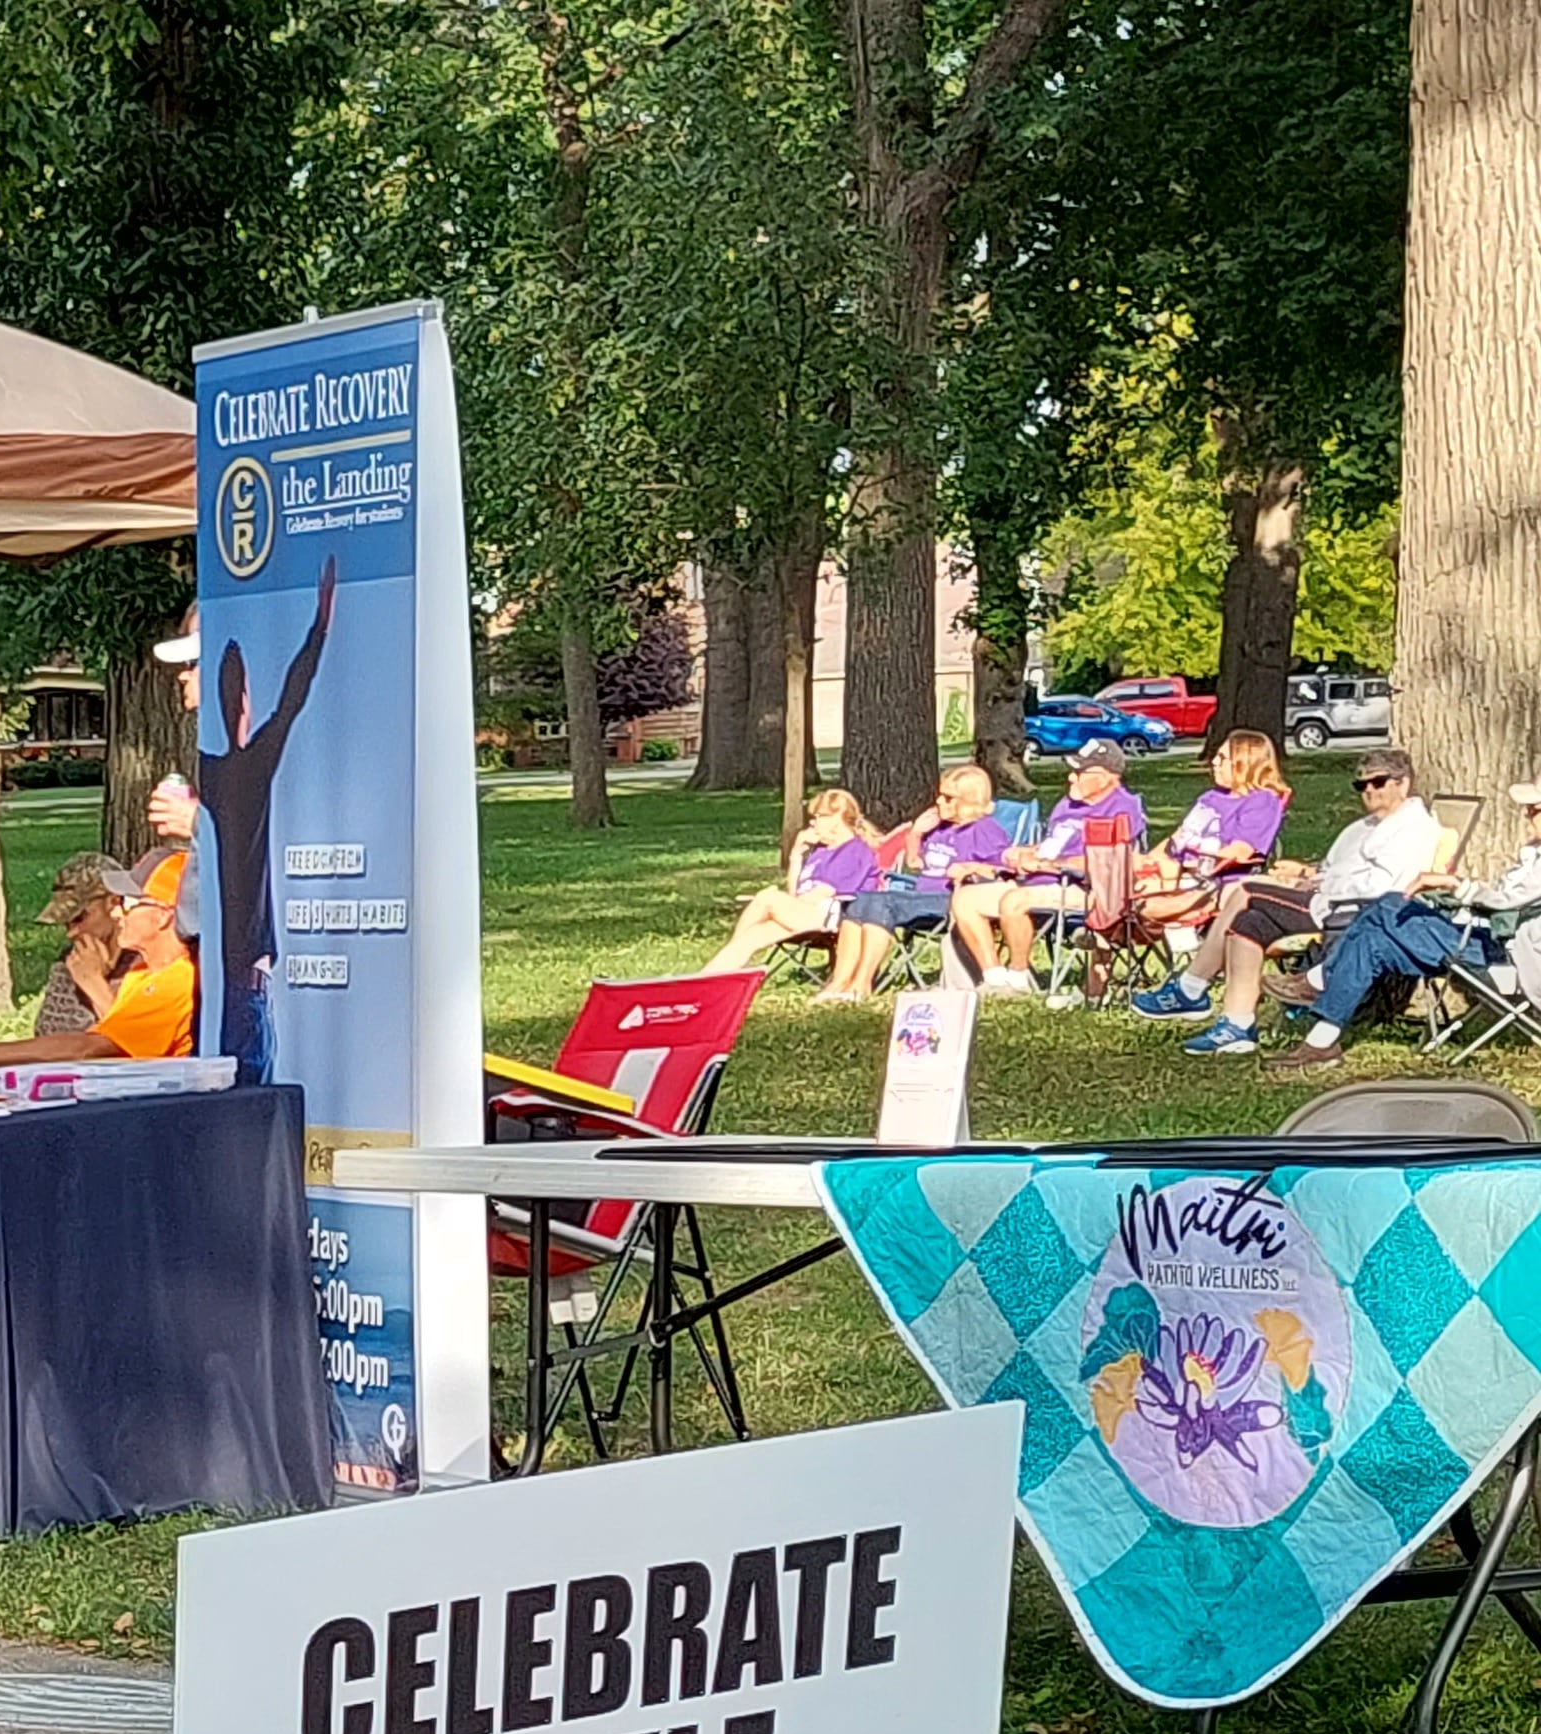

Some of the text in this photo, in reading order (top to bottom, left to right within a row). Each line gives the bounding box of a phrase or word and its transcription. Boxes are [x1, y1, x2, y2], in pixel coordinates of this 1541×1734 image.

[282, 452, 413, 507] the Landing
[1198, 1265, 1280, 1291] WELLNESS
